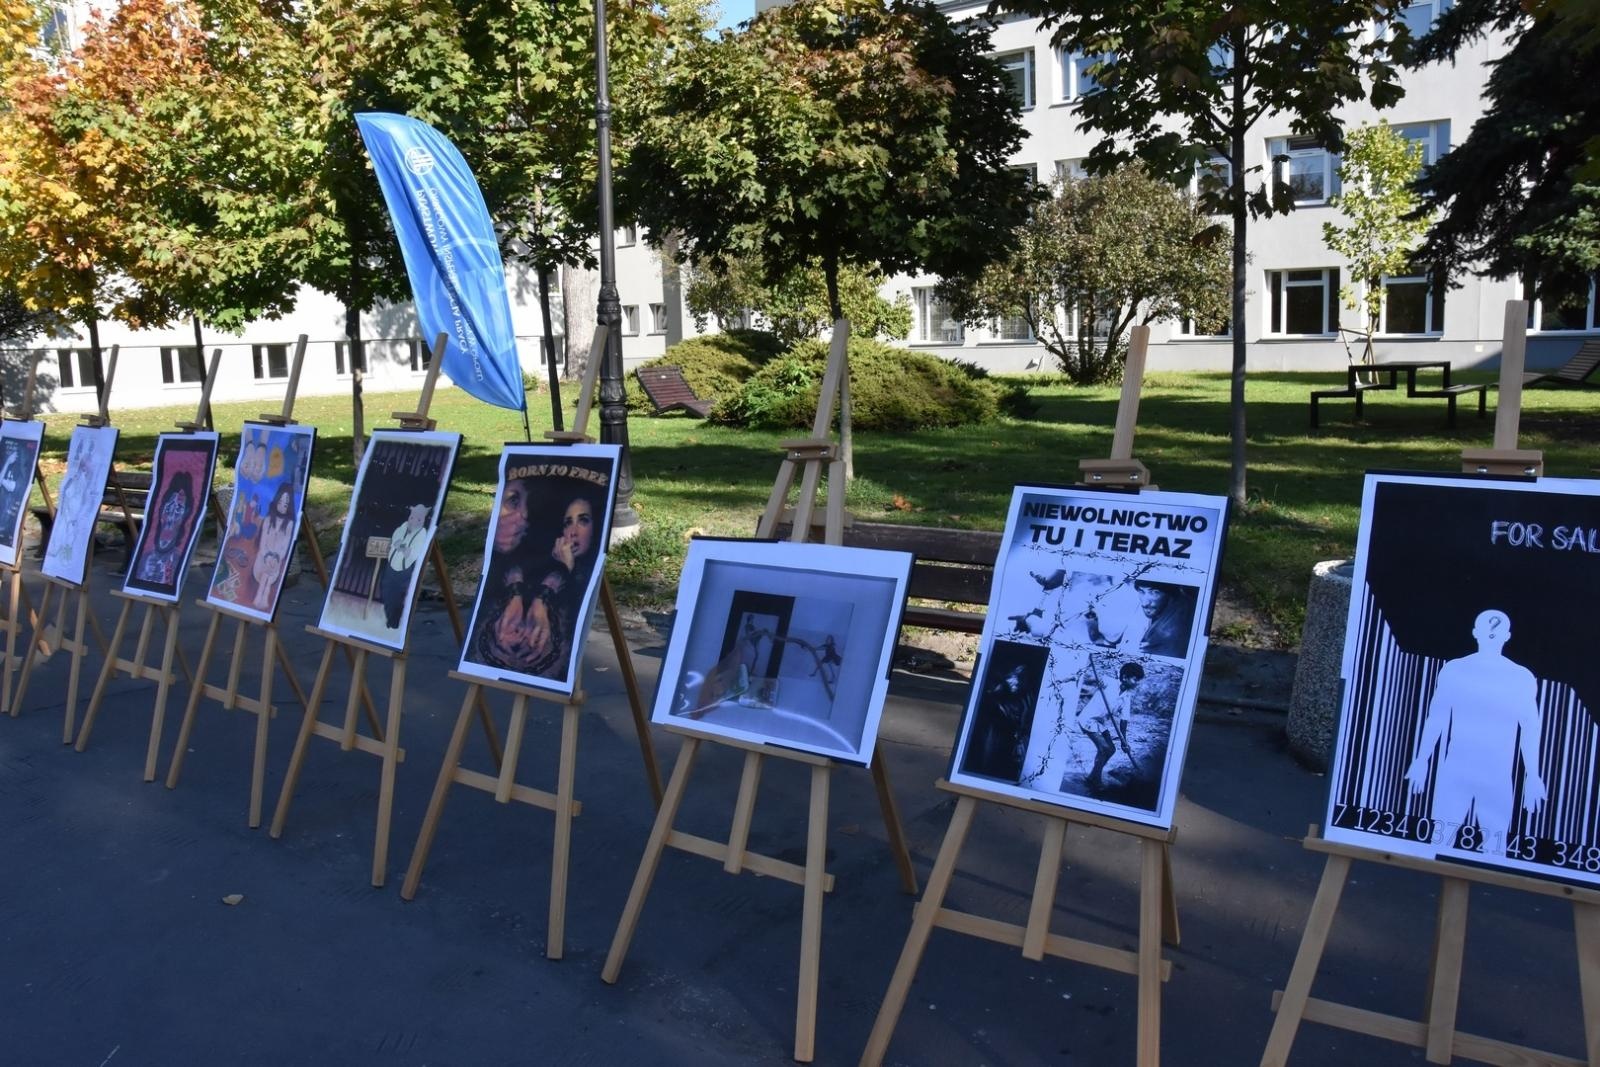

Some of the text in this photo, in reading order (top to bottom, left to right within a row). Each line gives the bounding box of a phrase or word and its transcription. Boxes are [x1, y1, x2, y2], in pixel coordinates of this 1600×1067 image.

[508, 464, 609, 486] BORN TO FREE
[1023, 502, 1208, 533] NIEWOLNICTWO
[1030, 524, 1193, 559] TU I TERAZ
[1490, 520, 1544, 548] FOR
